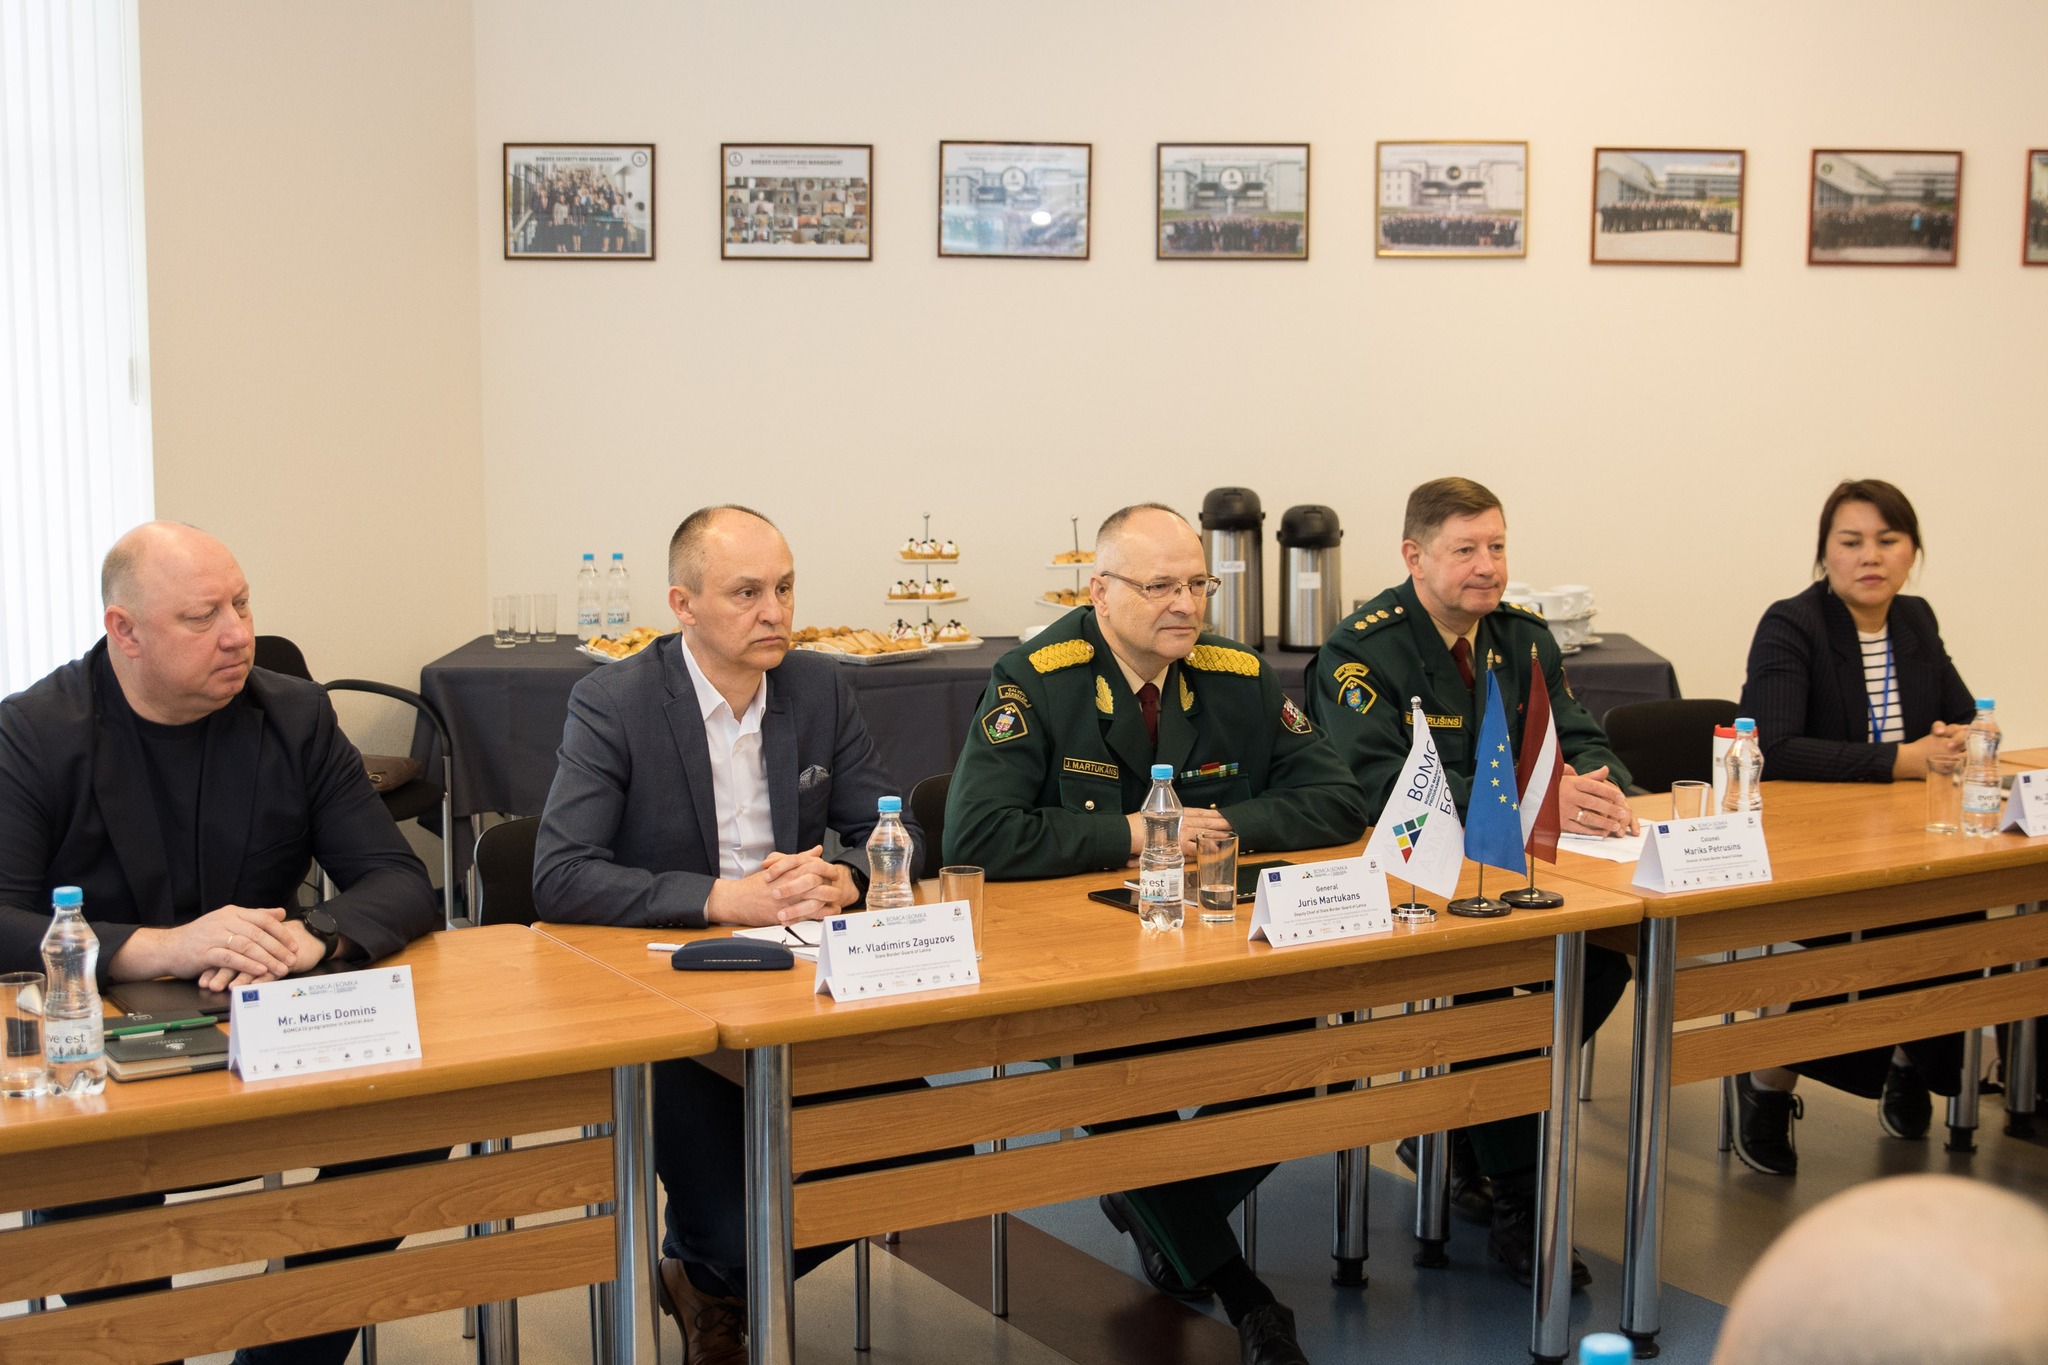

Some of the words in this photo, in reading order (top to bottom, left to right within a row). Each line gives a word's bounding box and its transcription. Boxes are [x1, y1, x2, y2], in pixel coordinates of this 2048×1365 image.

[1407, 740, 1437, 802] BOMC
[1701, 835, 1720, 843] Colonel
[1684, 846, 1708, 855] Mariks
[1708, 843, 1742, 853] Petrusins
[1316, 884, 1339, 892] General
[1298, 897, 1318, 908] Juris
[1319, 892, 1361, 905] Martukans
[848, 946, 864, 955] Mr.
[865, 940, 911, 953] Vladimirs
[912, 935, 955, 948] Zaguzovs
[278, 1016, 296, 1026] Mr.
[300, 1011, 332, 1023] Maris
[334, 1006, 377, 1019] Domins
[308, 1023, 337, 1031] programme
[65, 1032, 87, 1044] est
